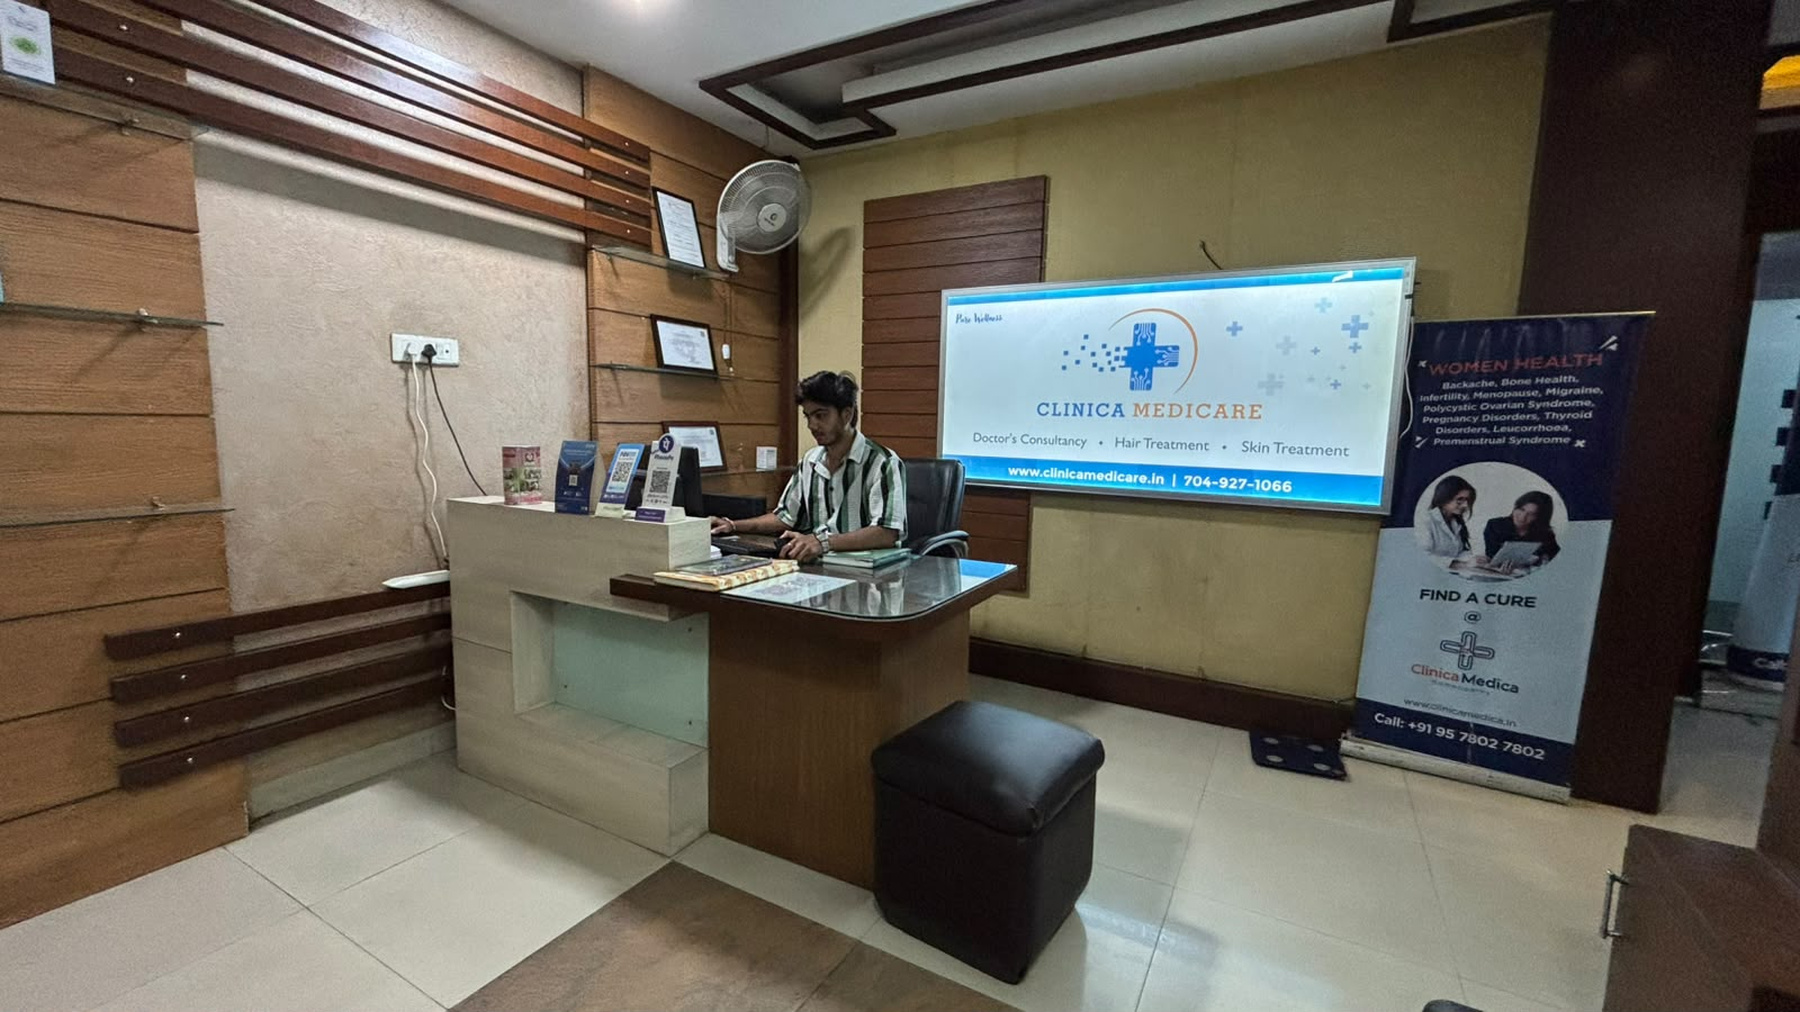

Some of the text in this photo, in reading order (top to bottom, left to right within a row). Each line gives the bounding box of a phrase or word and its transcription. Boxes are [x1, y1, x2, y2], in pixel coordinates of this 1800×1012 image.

[1429, 353, 1603, 375] WOMEN HEALTH
[1442, 375, 1579, 390] Backache, Bone Health,
[1420, 386, 1603, 402] Infertility, Menopause, Migraine,
[1036, 402, 1262, 420] CLINICA MEDICARE
[1423, 399, 1595, 413] Polycystic Ovarian Syndrome,
[1422, 410, 1593, 424] Pregnancy Disorders, Thyroid
[1436, 423, 1572, 435] Disorders, Leucorrhoea,
[972, 432, 1087, 449] Doctor's Consultancy
[1115, 436, 1209, 451] Hair Treatment
[1241, 440, 1350, 458] Skin Treatment
[1433, 435, 1571, 446] Premenstrual Syndrome
[1008, 465, 1165, 486] www.clinicamedicare.in
[1184, 474, 1292, 493] 704-927-1066
[1419, 589, 1537, 608] FIND A CURE
[1464, 611, 1482, 624] @
[1411, 663, 1459, 682] Clinica
[1461, 673, 1519, 694] Medica
[1404, 698, 1517, 728] www.clinicamedica.in
[1374, 712, 1546, 761] Call: +91 95 7802 7802
